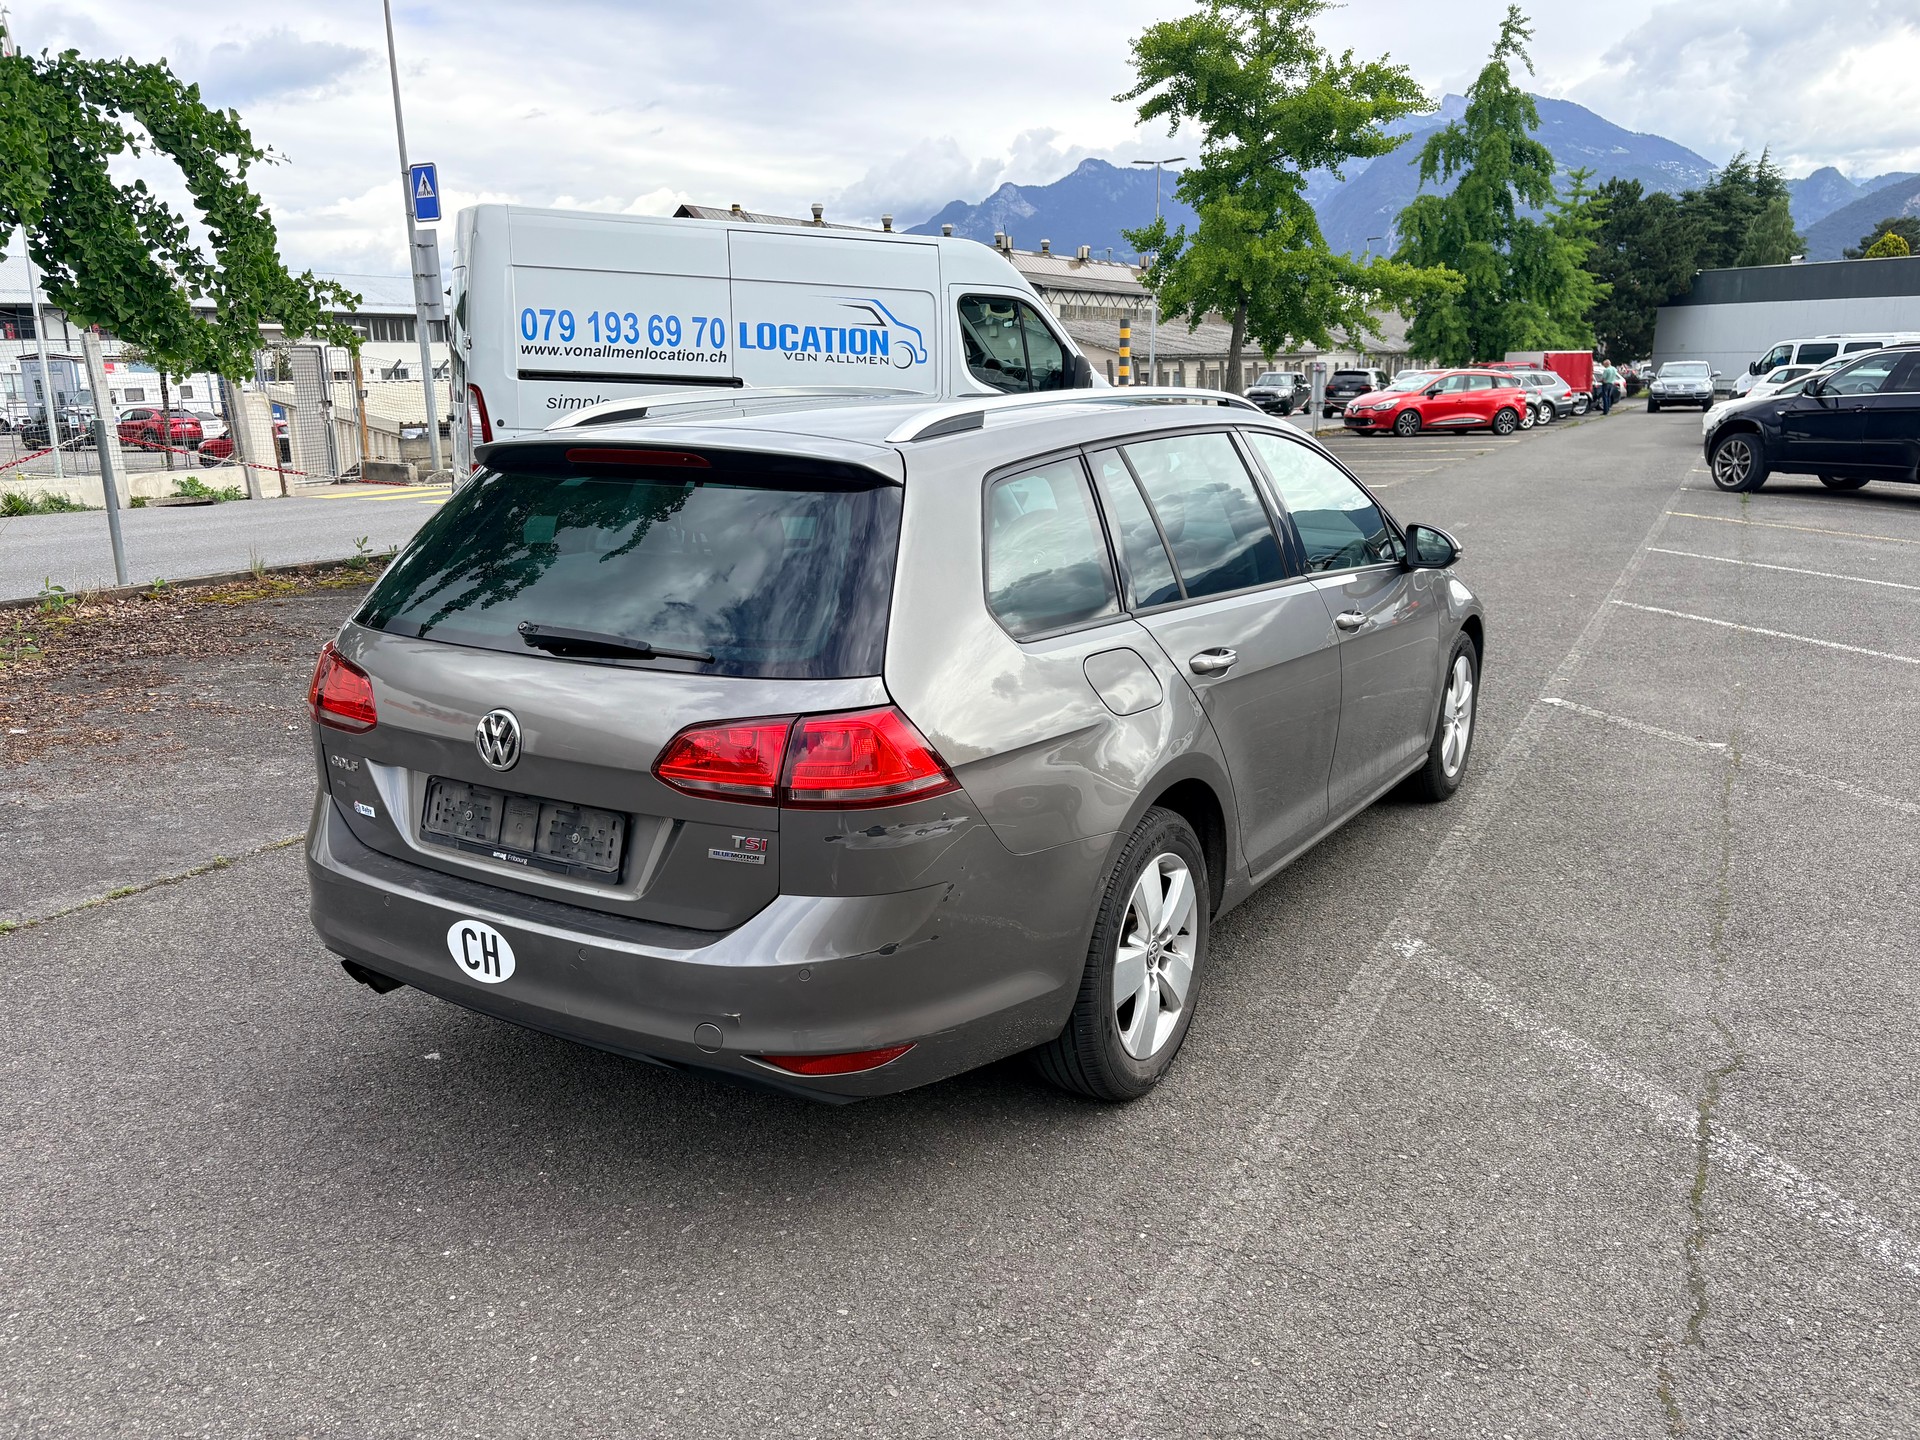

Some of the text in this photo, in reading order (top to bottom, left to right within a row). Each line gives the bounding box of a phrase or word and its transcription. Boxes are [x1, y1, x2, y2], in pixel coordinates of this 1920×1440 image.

[521, 308, 726, 349] 079 193 69 70
[739, 322, 889, 356] LOCATION
[521, 344, 727, 363] www.vonallmenlocation.ch
[783, 352, 889, 365] VON ALLMEN
[546, 394, 611, 409] simpl
[331, 755, 359, 772] GOLF
[731, 834, 768, 852] TSI
[493, 851, 528, 865] amag Fribourg
[712, 850, 760, 861] BLUEMOTION
[461, 927, 501, 978] CH
